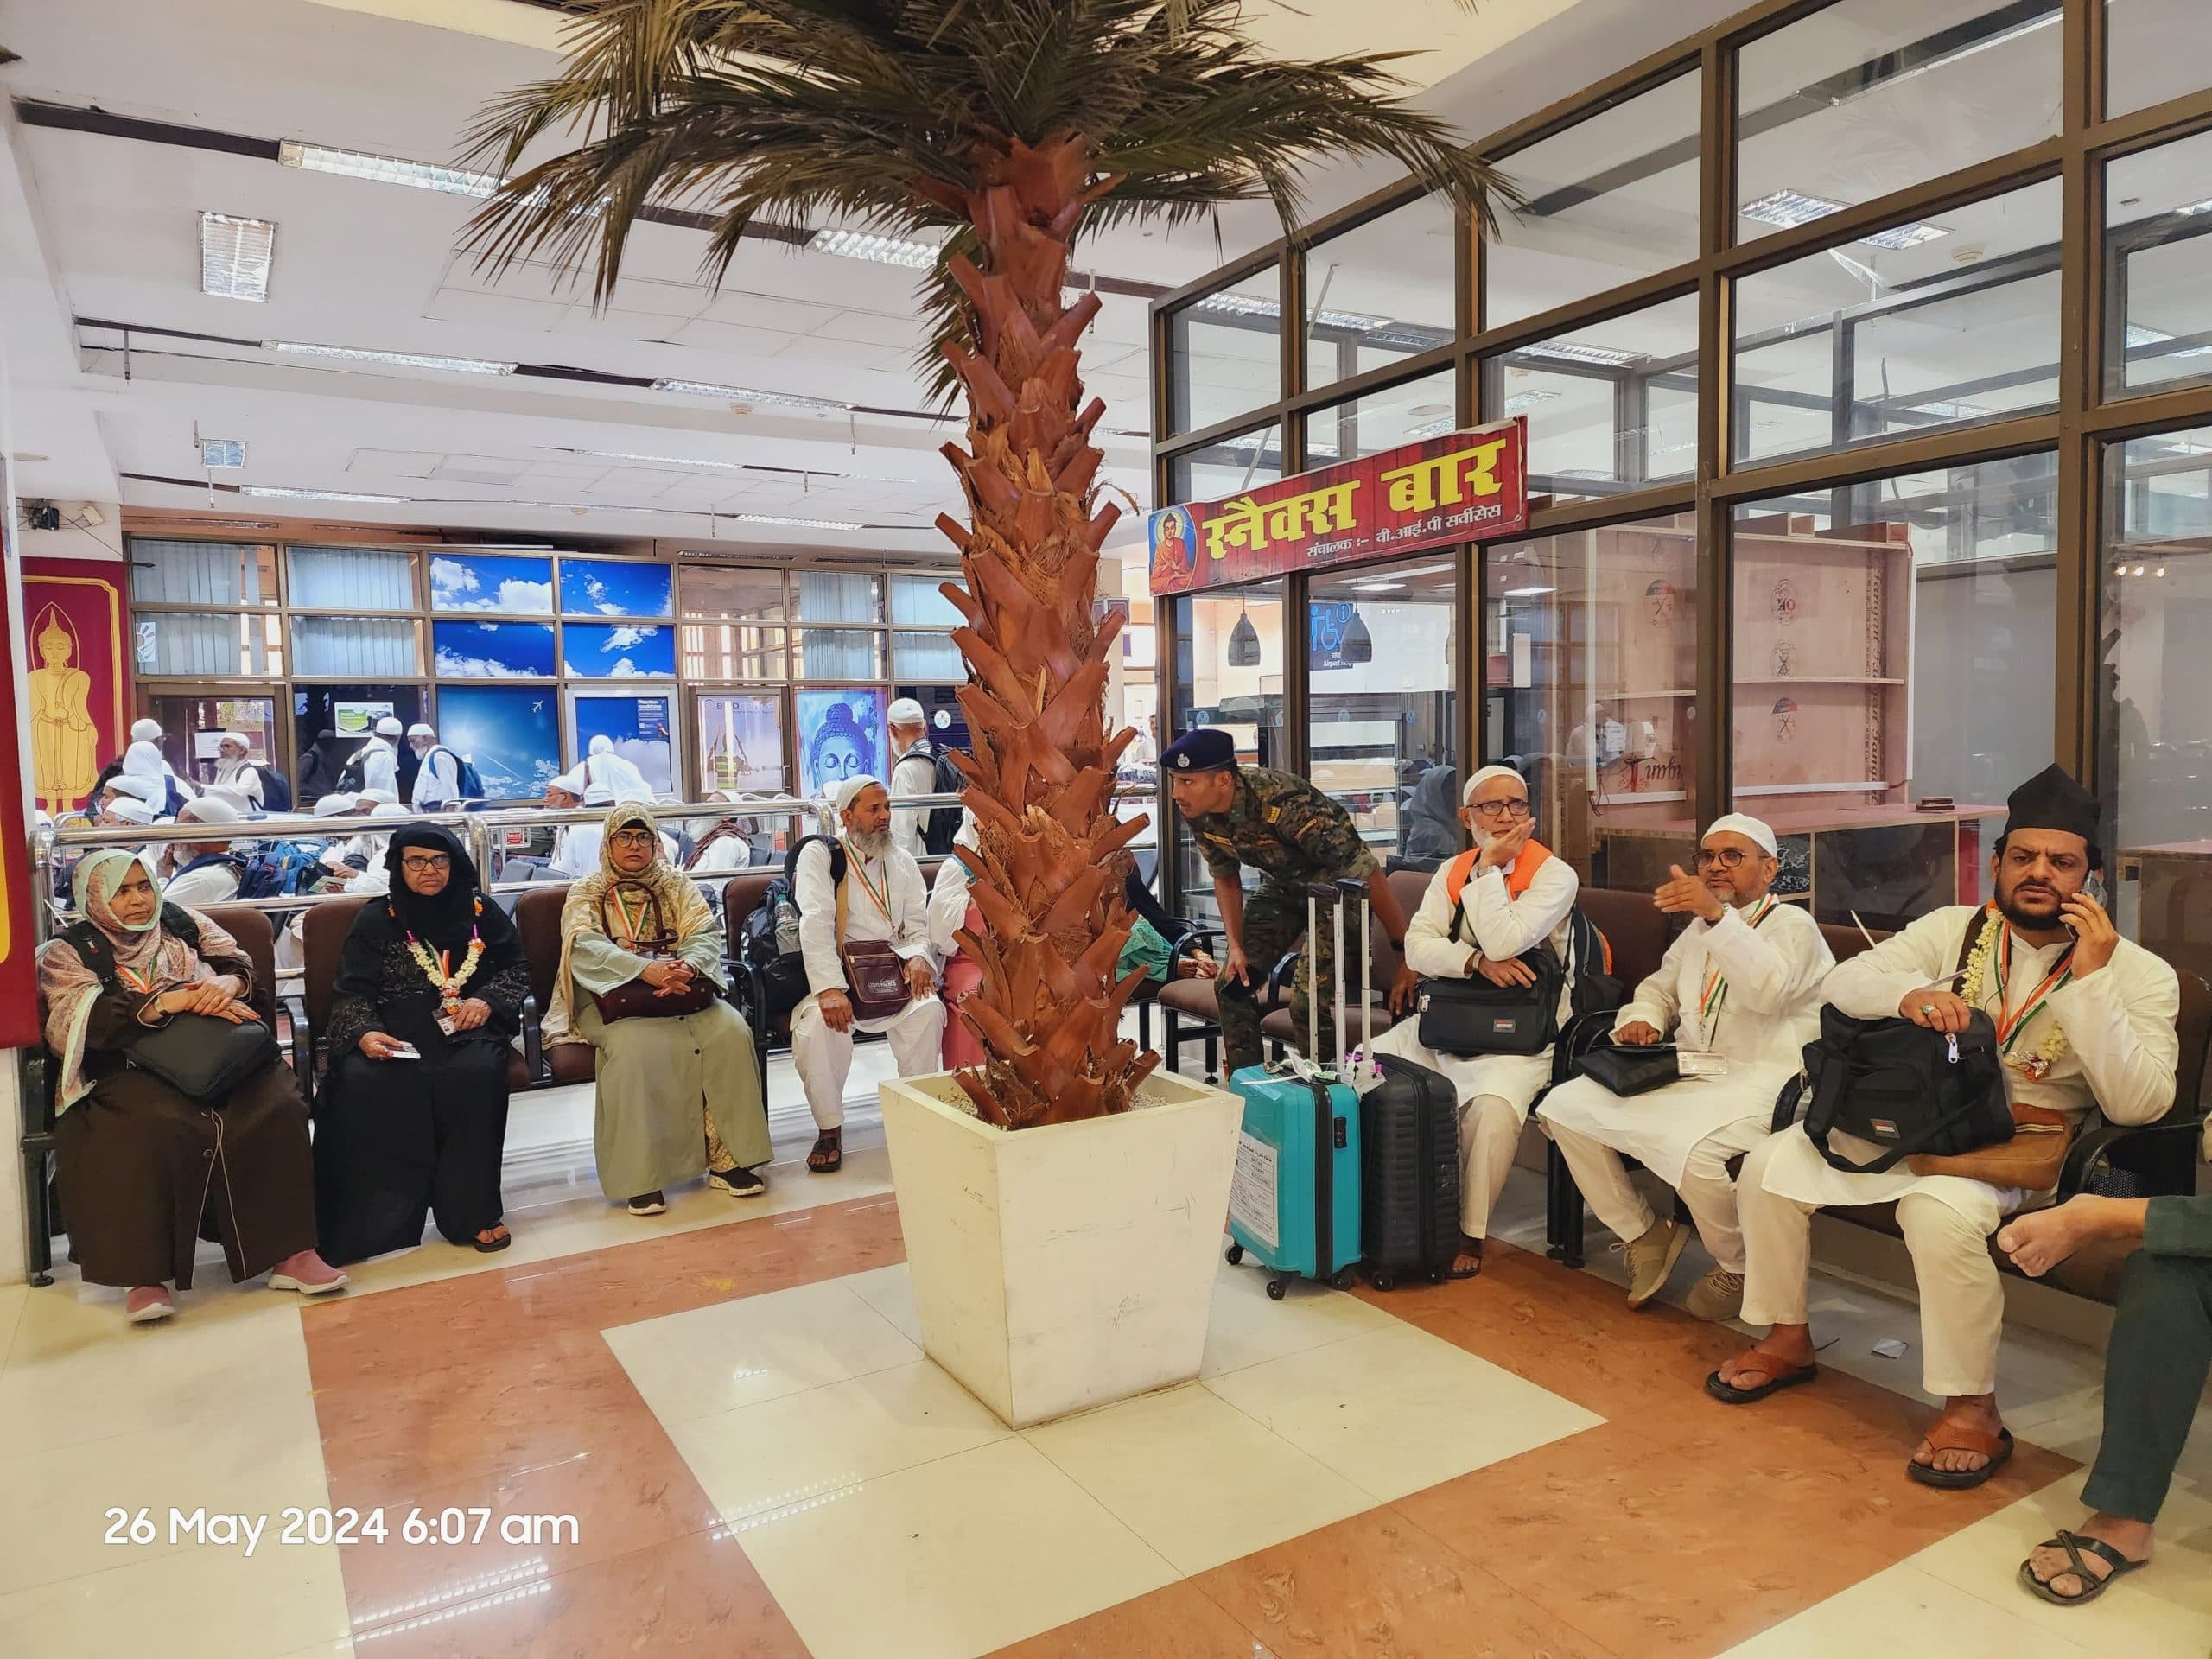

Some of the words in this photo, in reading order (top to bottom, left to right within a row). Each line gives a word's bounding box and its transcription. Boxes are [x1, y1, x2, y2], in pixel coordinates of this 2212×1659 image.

[1201, 479, 1361, 560] स्नैक्स
[1380, 438, 1507, 512] बार
[1306, 537, 1352, 558] संचालक
[1323, 658, 1340, 668] Airport
